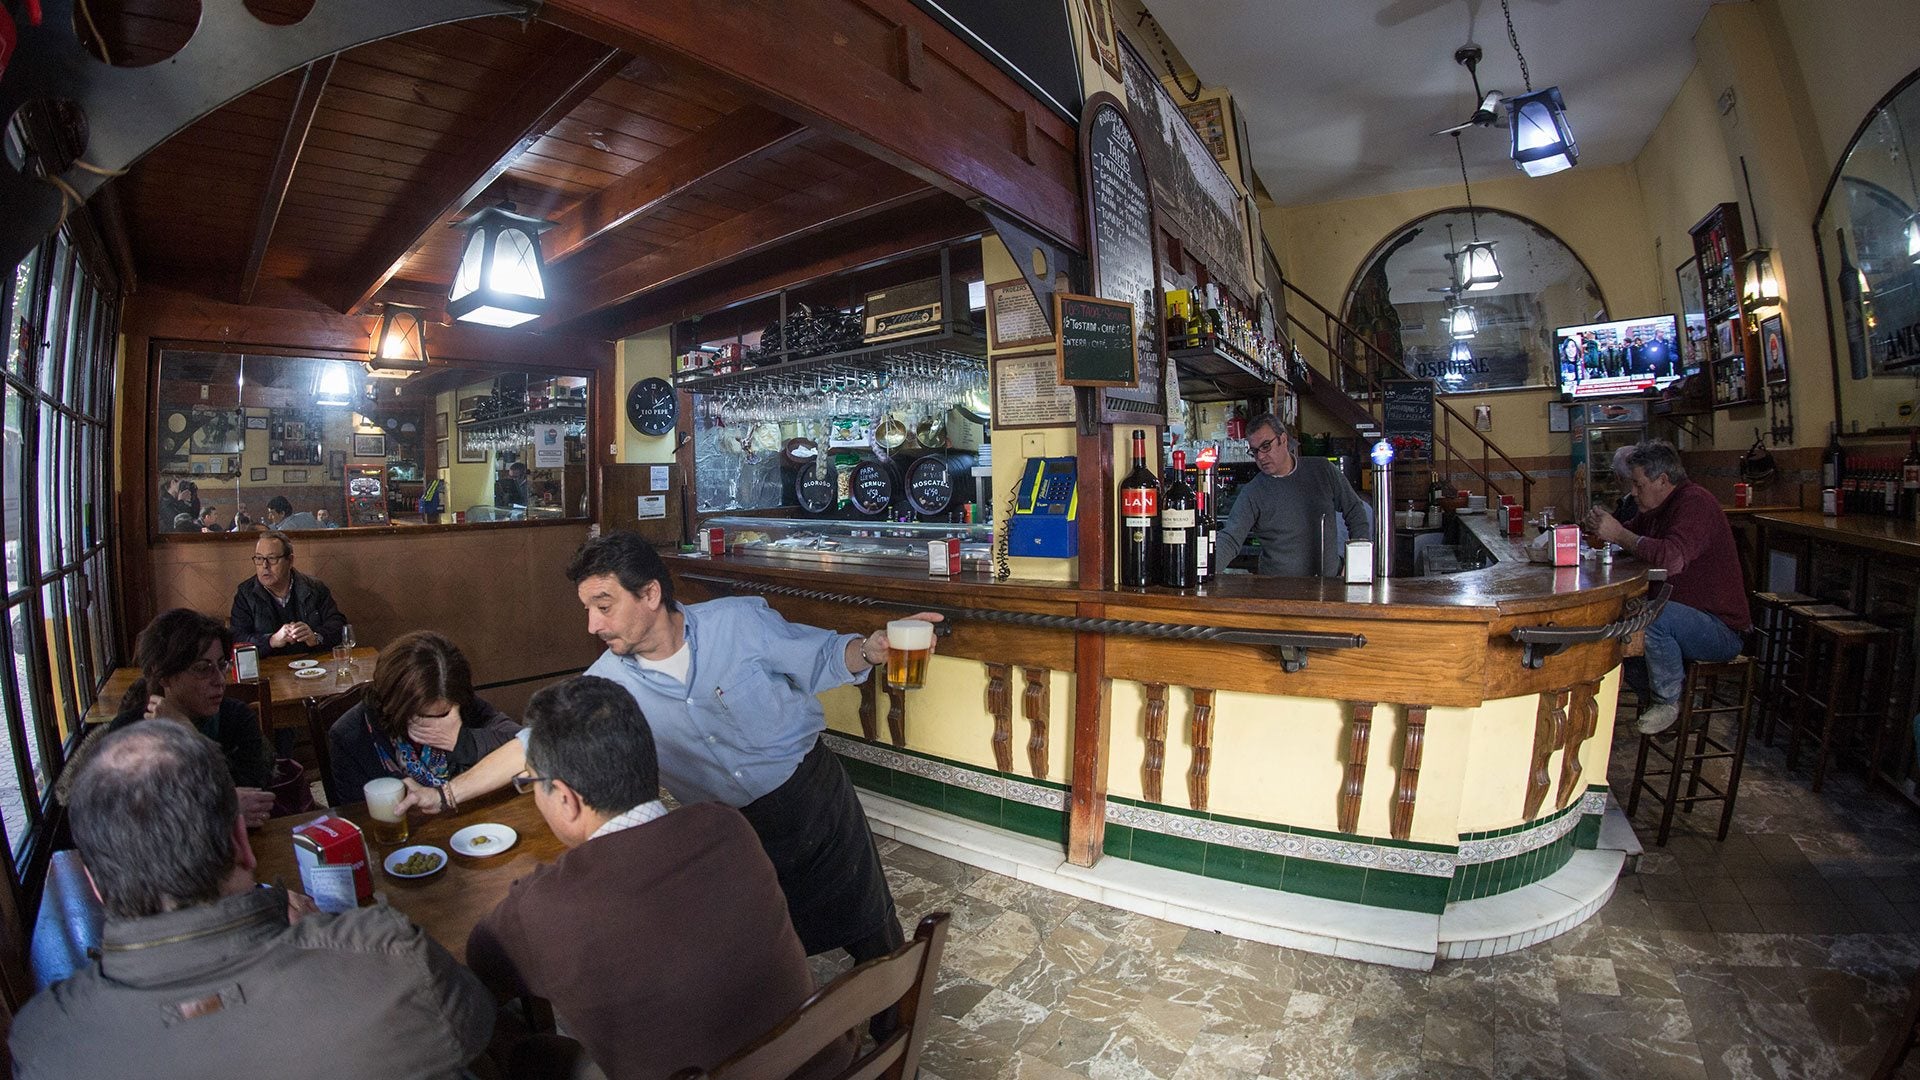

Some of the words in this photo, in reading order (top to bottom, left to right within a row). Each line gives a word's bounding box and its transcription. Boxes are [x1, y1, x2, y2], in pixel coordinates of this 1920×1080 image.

[1106, 137, 1130, 172] TAPAS
[1099, 152, 1124, 182] TORTILLA
[1100, 206, 1126, 231] TOMATES
[1102, 220, 1114, 241] PEZ
[1417, 357, 1490, 378] OSBORNE
[803, 480, 832, 488] OLOROSO
[911, 479, 950, 489] MOSCATEL
[1125, 498, 1152, 506] LAN
